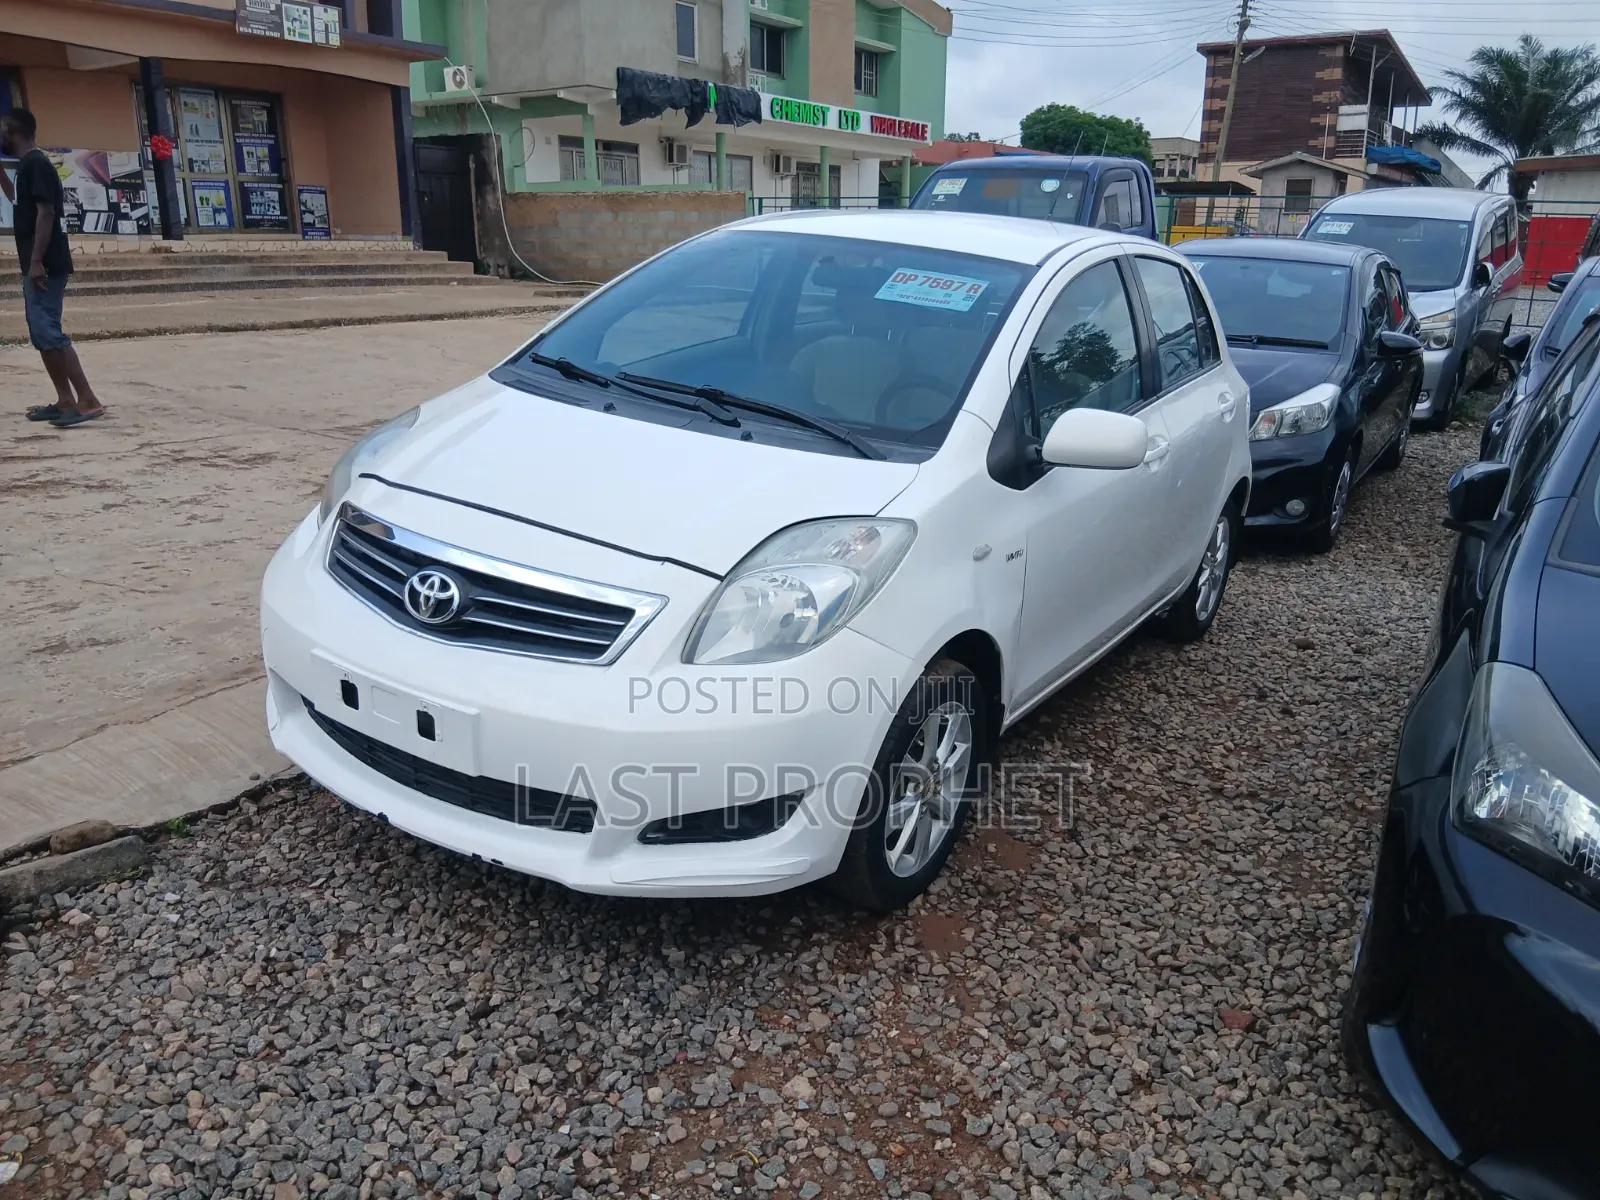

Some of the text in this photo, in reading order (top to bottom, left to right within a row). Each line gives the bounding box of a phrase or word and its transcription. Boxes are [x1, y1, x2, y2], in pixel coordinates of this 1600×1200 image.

[770, 96, 928, 141] CHEMIST LTD WHOLESALE
[891, 272, 983, 295] DP 7597 R
